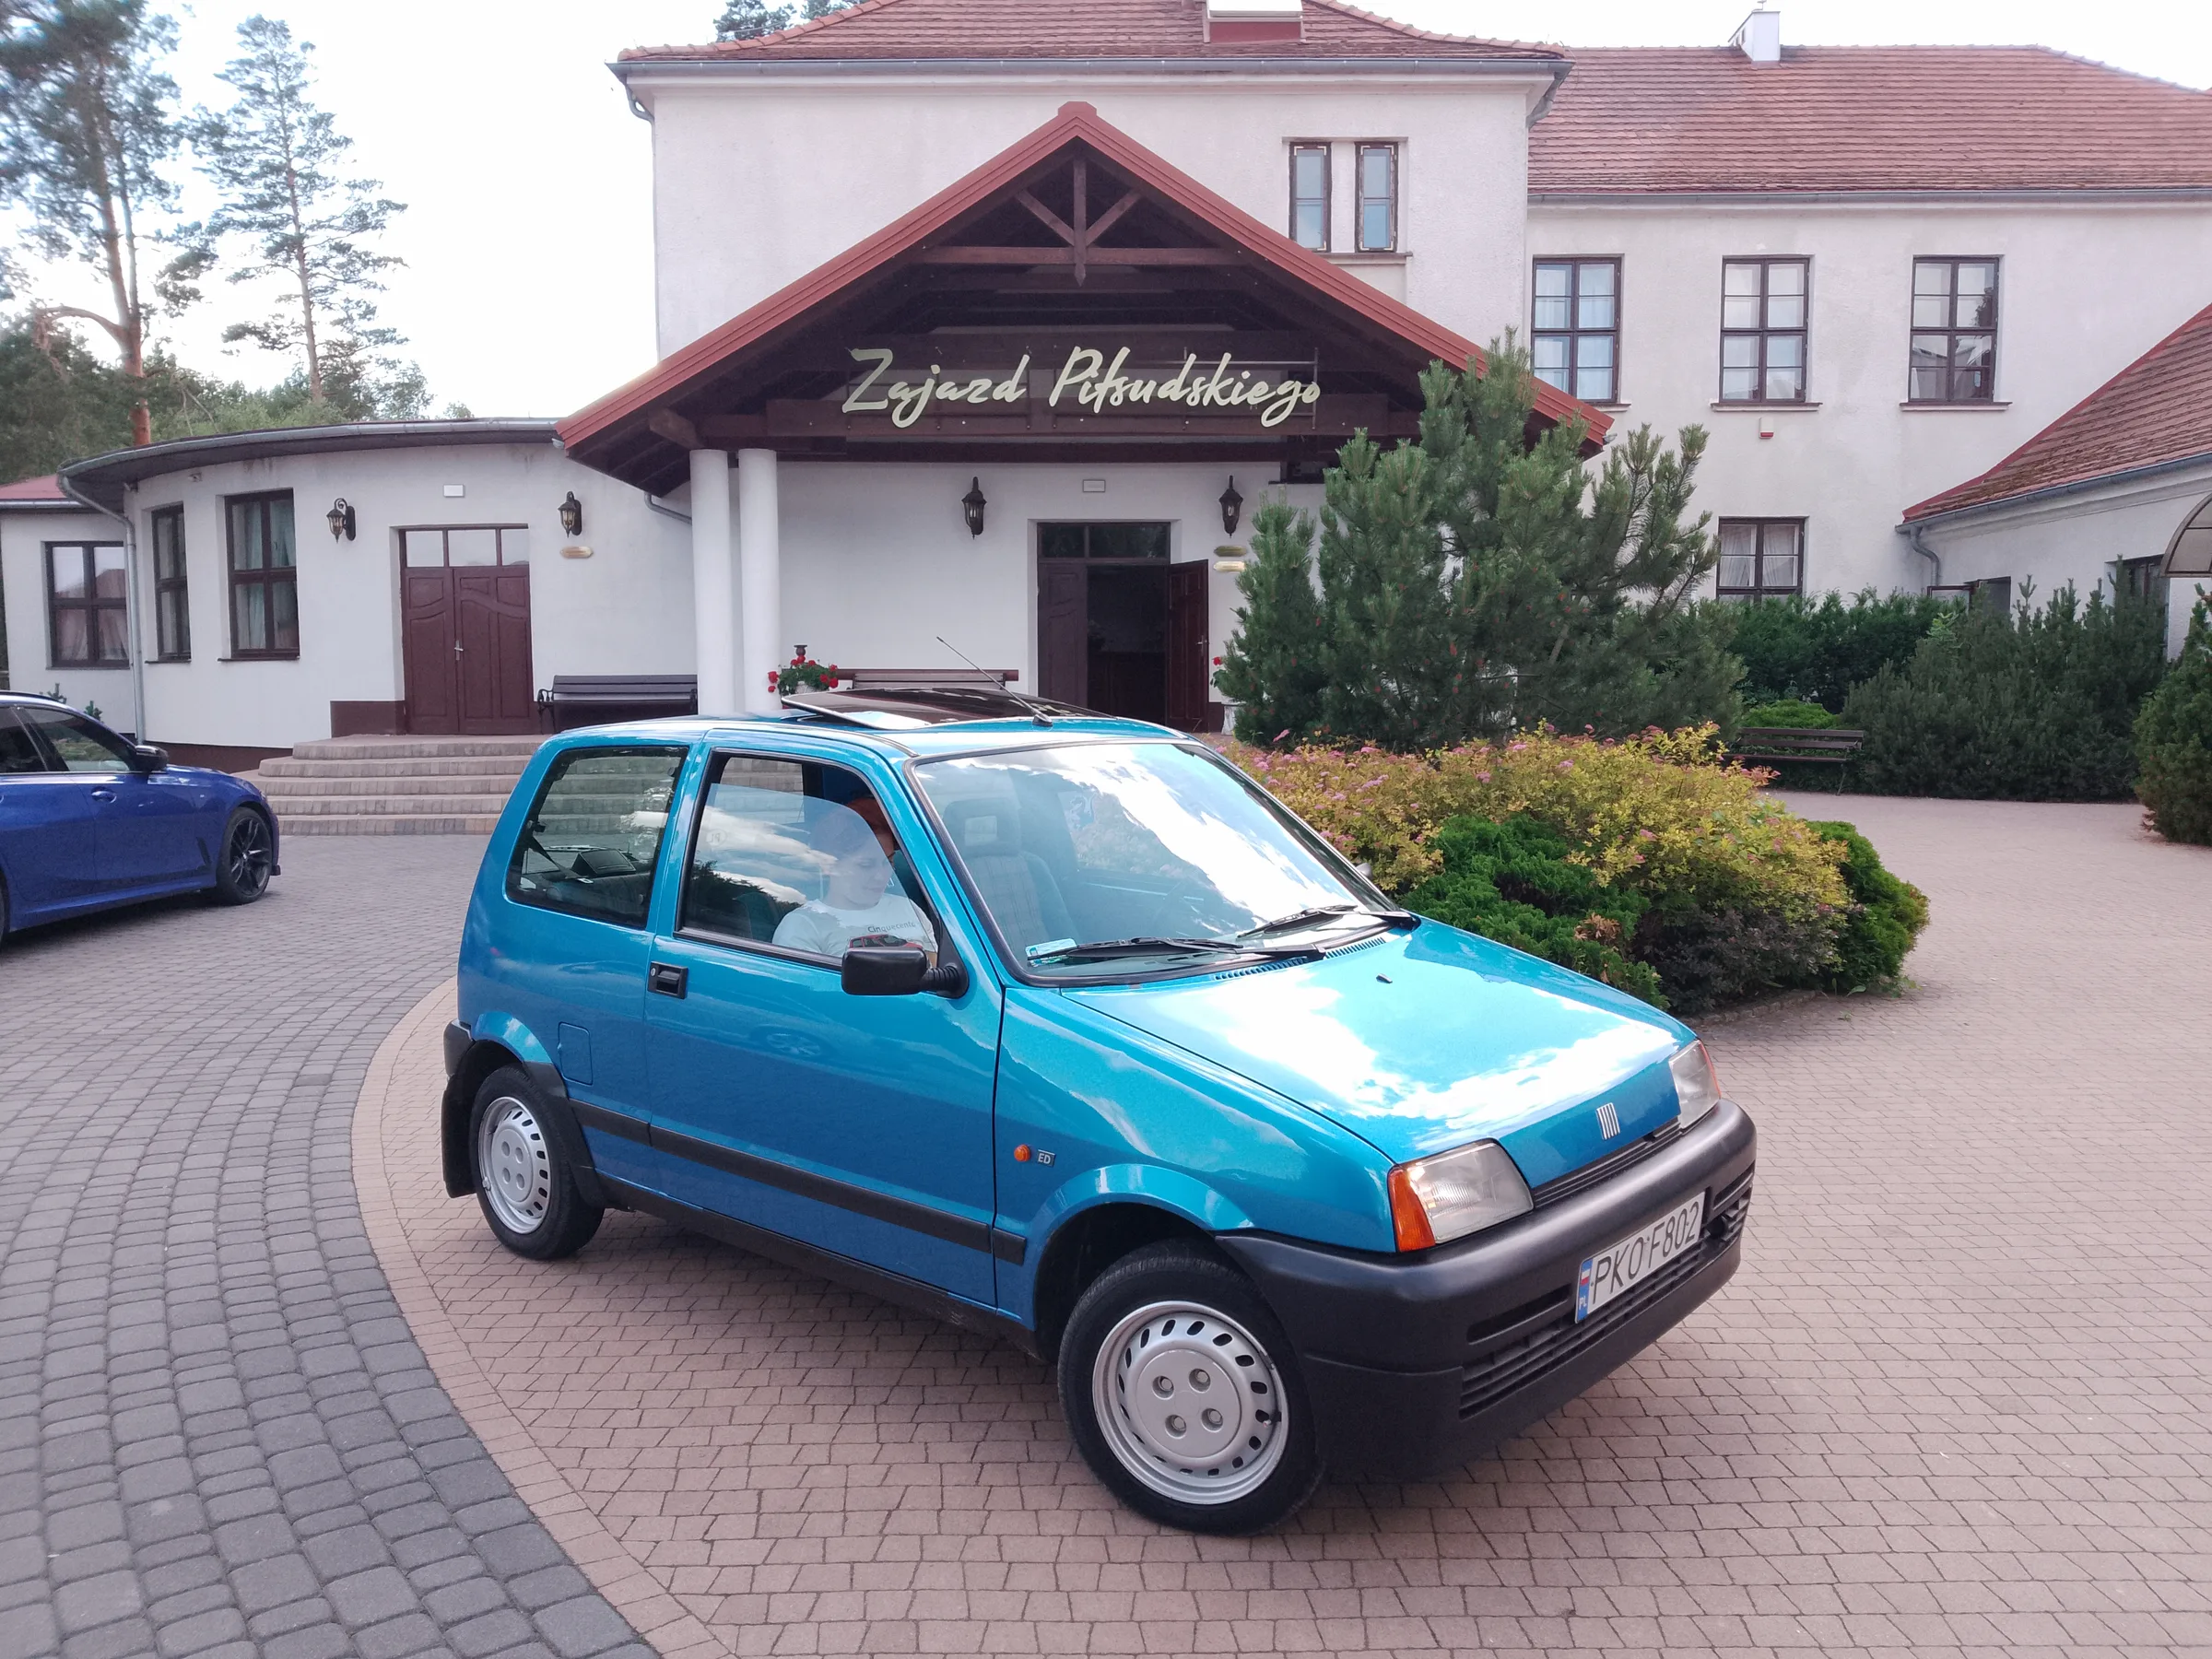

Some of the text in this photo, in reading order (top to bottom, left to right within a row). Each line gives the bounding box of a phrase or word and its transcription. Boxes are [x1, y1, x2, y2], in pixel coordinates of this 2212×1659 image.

[842, 346, 1321, 428] Zajazd Piłsudskiego
[1038, 1153, 1051, 1164] ED
[1579, 1295, 1587, 1310] PL
